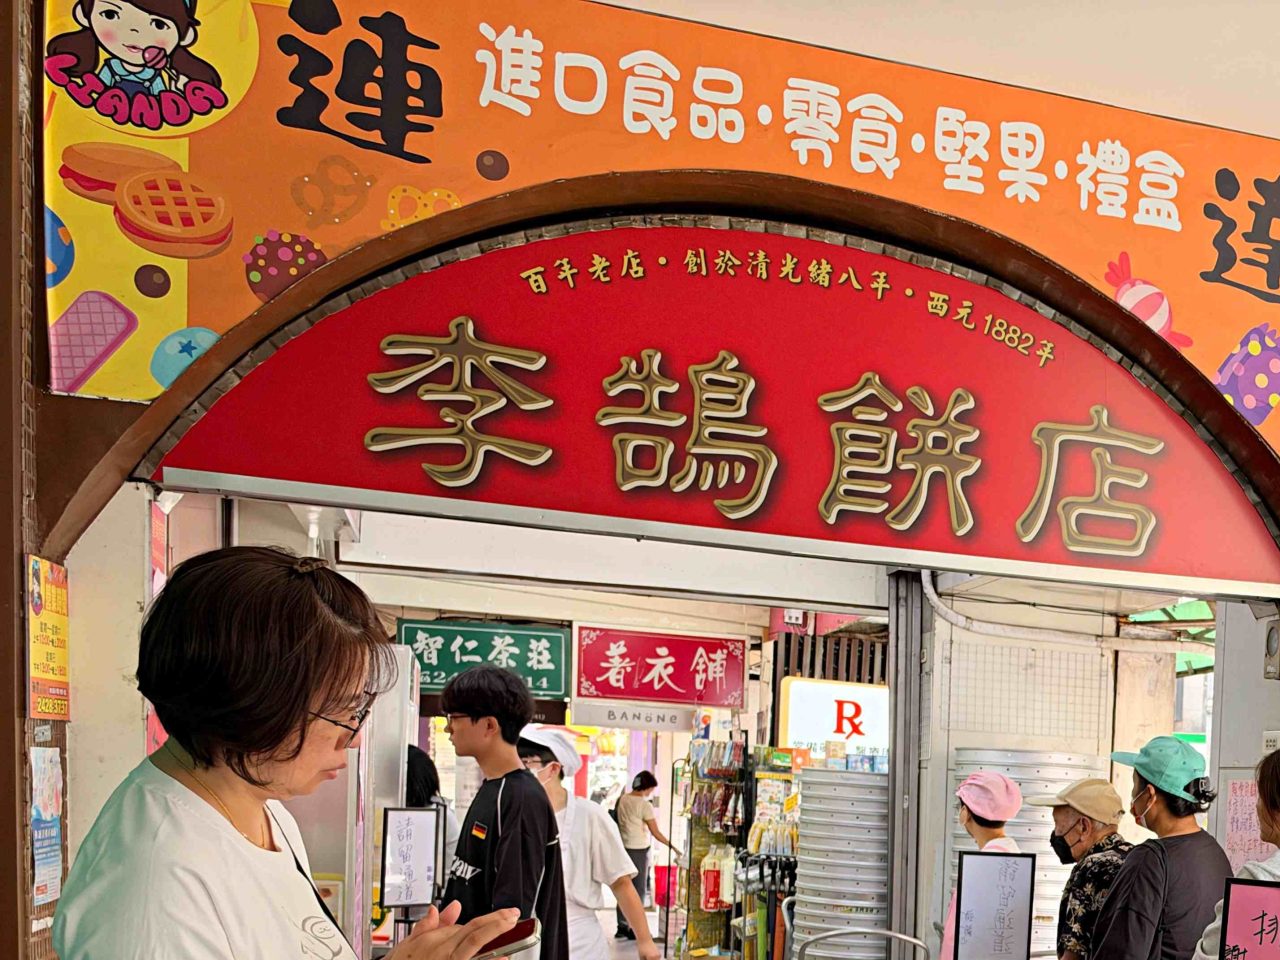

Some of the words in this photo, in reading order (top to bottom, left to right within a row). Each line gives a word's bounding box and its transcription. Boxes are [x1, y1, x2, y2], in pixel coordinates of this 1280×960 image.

[44, 54, 228, 130] LIANDA
[276, 0, 443, 164] 連
[363, 315, 1165, 557] 李鵠餅店
